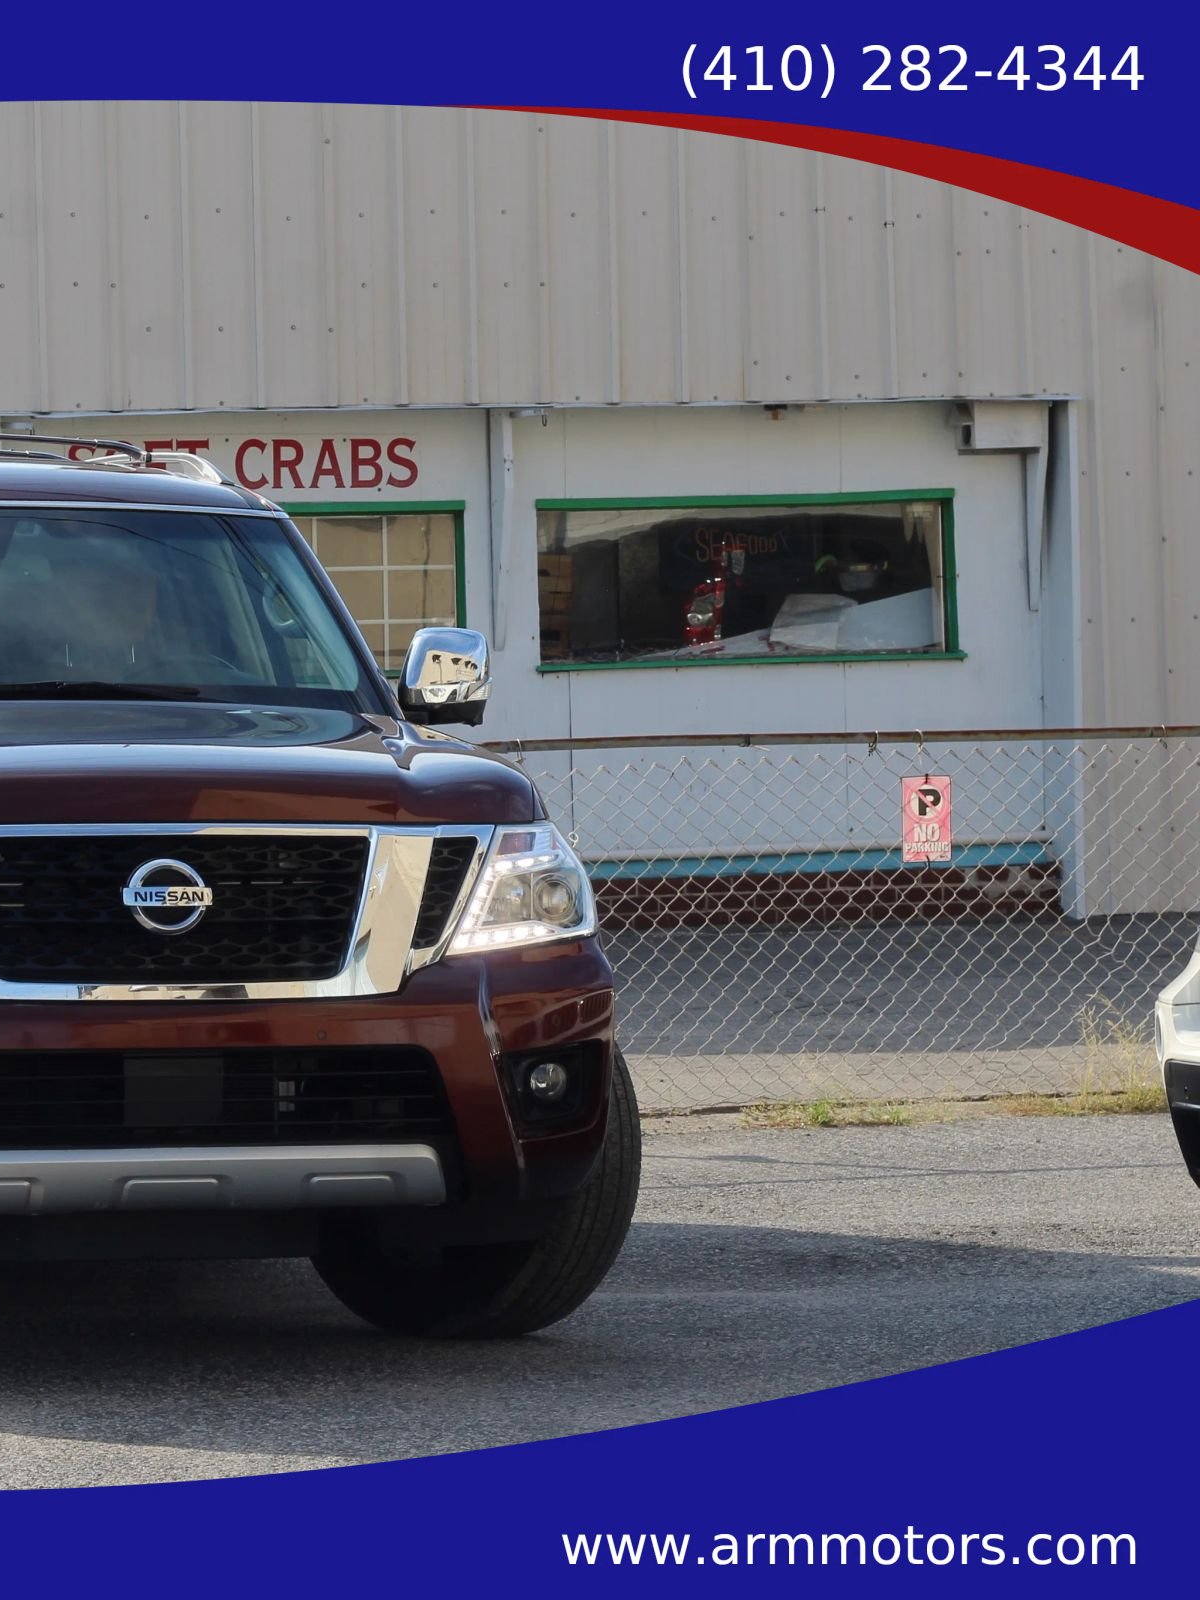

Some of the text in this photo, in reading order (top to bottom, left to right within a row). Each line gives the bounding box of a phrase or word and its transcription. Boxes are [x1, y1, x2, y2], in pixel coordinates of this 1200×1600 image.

[234, 437, 419, 490] CRABS
[913, 823, 940, 842] NO
[905, 842, 950, 853] PARKING
[133, 890, 204, 903] NISSAN
